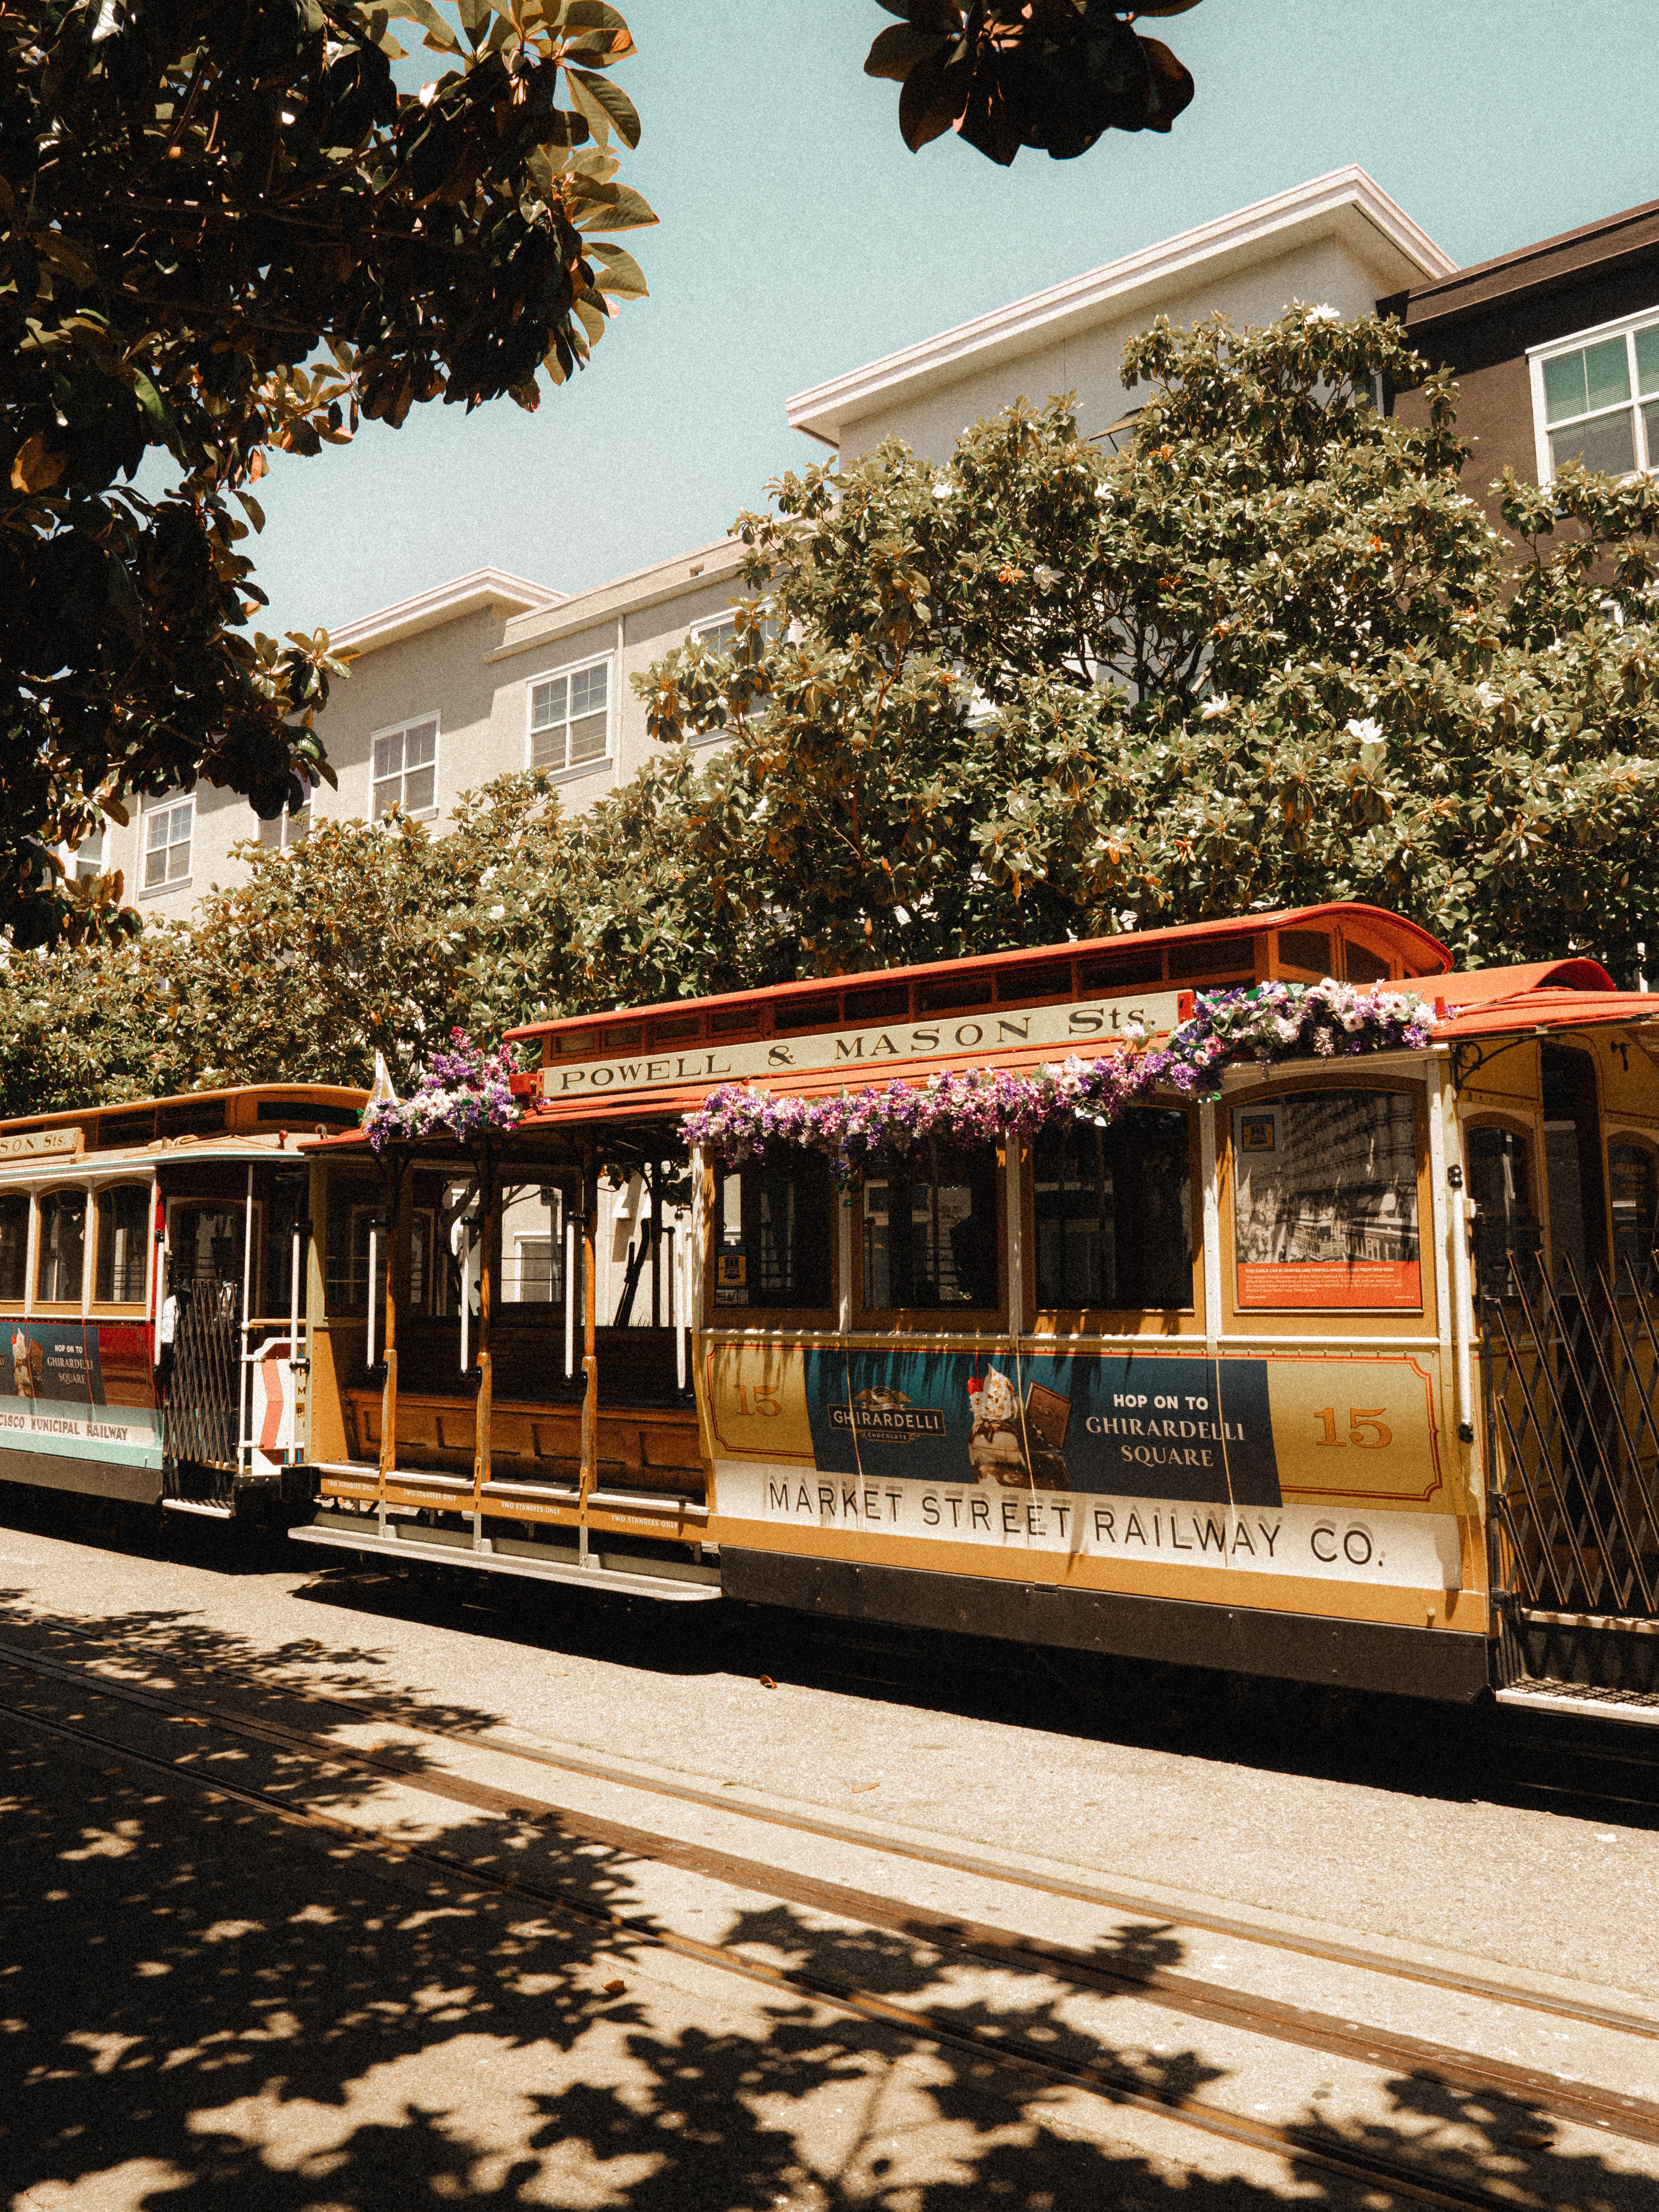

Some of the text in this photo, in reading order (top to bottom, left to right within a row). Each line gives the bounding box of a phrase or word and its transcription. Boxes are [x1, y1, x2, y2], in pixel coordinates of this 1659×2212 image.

[560, 1007, 1155, 1090] POWELL & MASON Sts.
[43, 1134, 65, 1147] Sts.
[58, 1373, 86, 1384] SQUARE
[733, 1385, 781, 1416] 15
[1113, 1393, 1209, 1410] HOP ON TO
[31, 1418, 80, 1434] MUNICIPAL
[86, 1424, 128, 1440] RAILWAY
[834, 1410, 939, 1429] GHIRARDELLI
[1085, 1416, 1245, 1441] GHIRARDELLI
[1313, 1407, 1393, 1448] 15
[1121, 1445, 1214, 1467] SQUARE
[339, 1481, 361, 1490] STANDEES
[417, 1491, 441, 1499] STANDEES
[516, 1503, 543, 1512] STANDEES
[611, 1514, 677, 1529] TWO STANDEES ONLY
[770, 1482, 1383, 1567] MARKET STREET RAILWAY CO.
